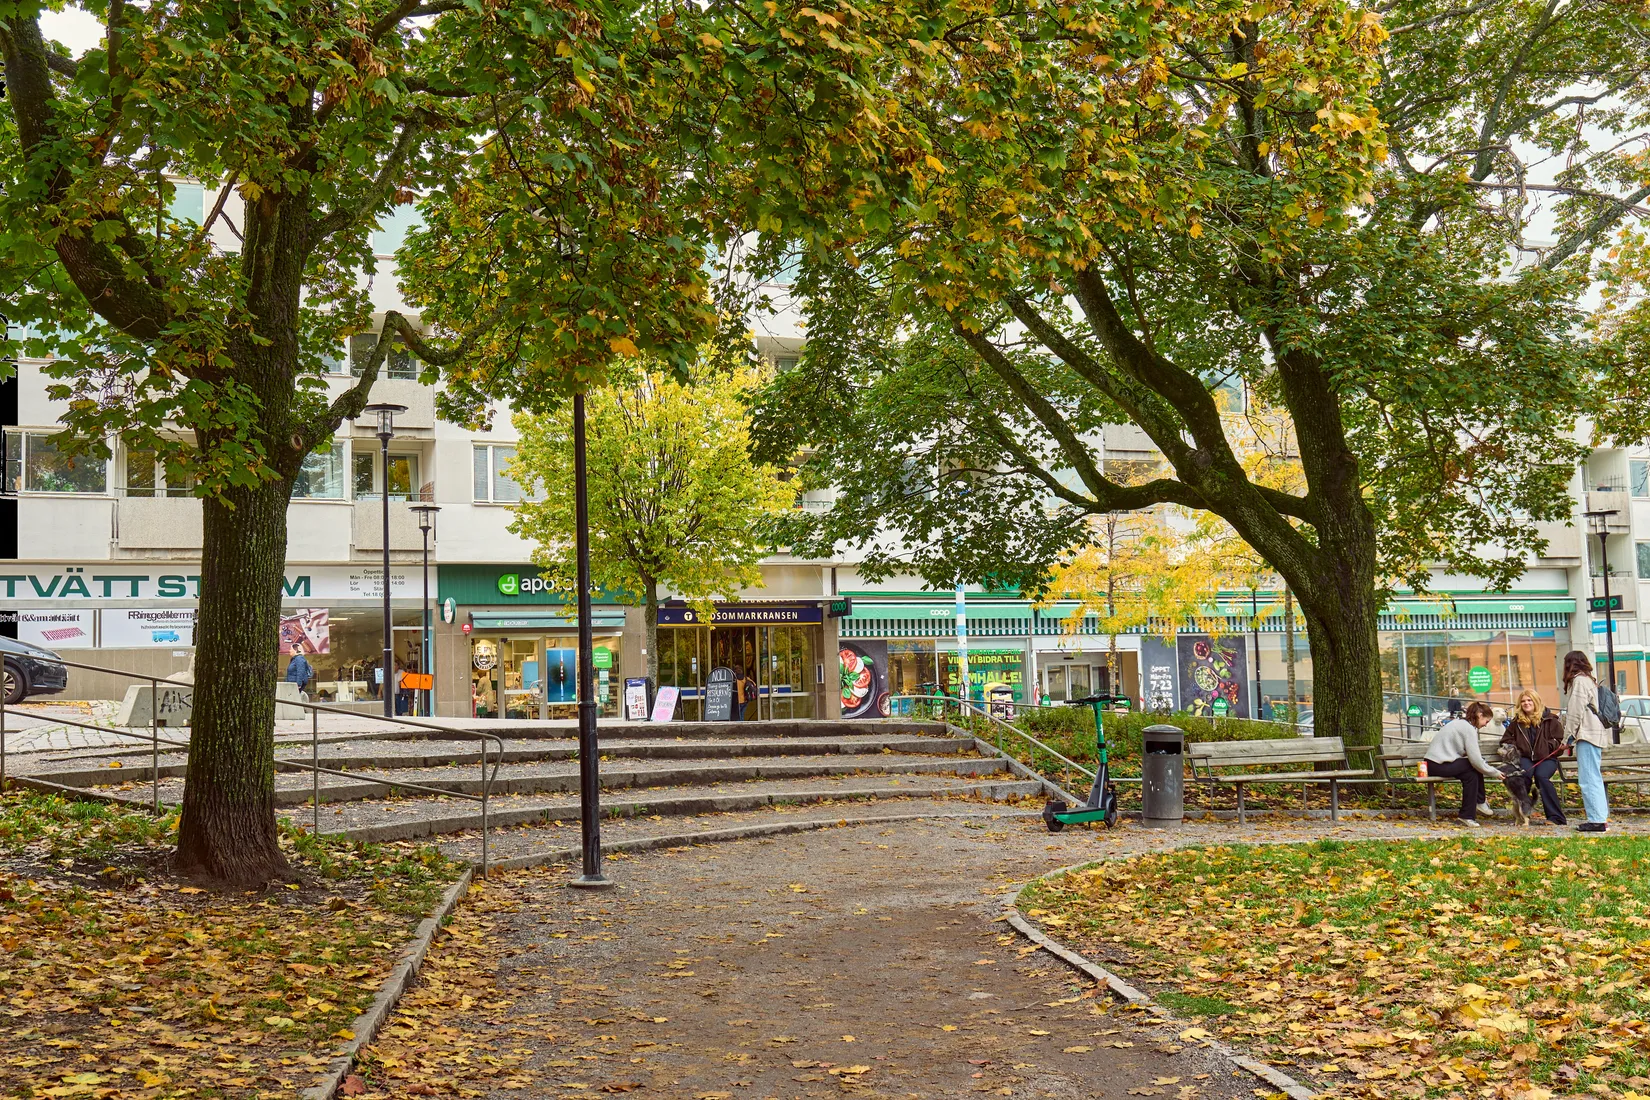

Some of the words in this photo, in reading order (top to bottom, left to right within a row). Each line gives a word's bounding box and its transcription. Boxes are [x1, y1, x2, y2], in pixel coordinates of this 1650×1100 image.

[0, 568, 149, 597] TVÄTT
[831, 601, 847, 613] coop
[1509, 604, 1525, 612] coop
[1593, 598, 1618, 608] cop
[930, 609, 950, 617] coop
